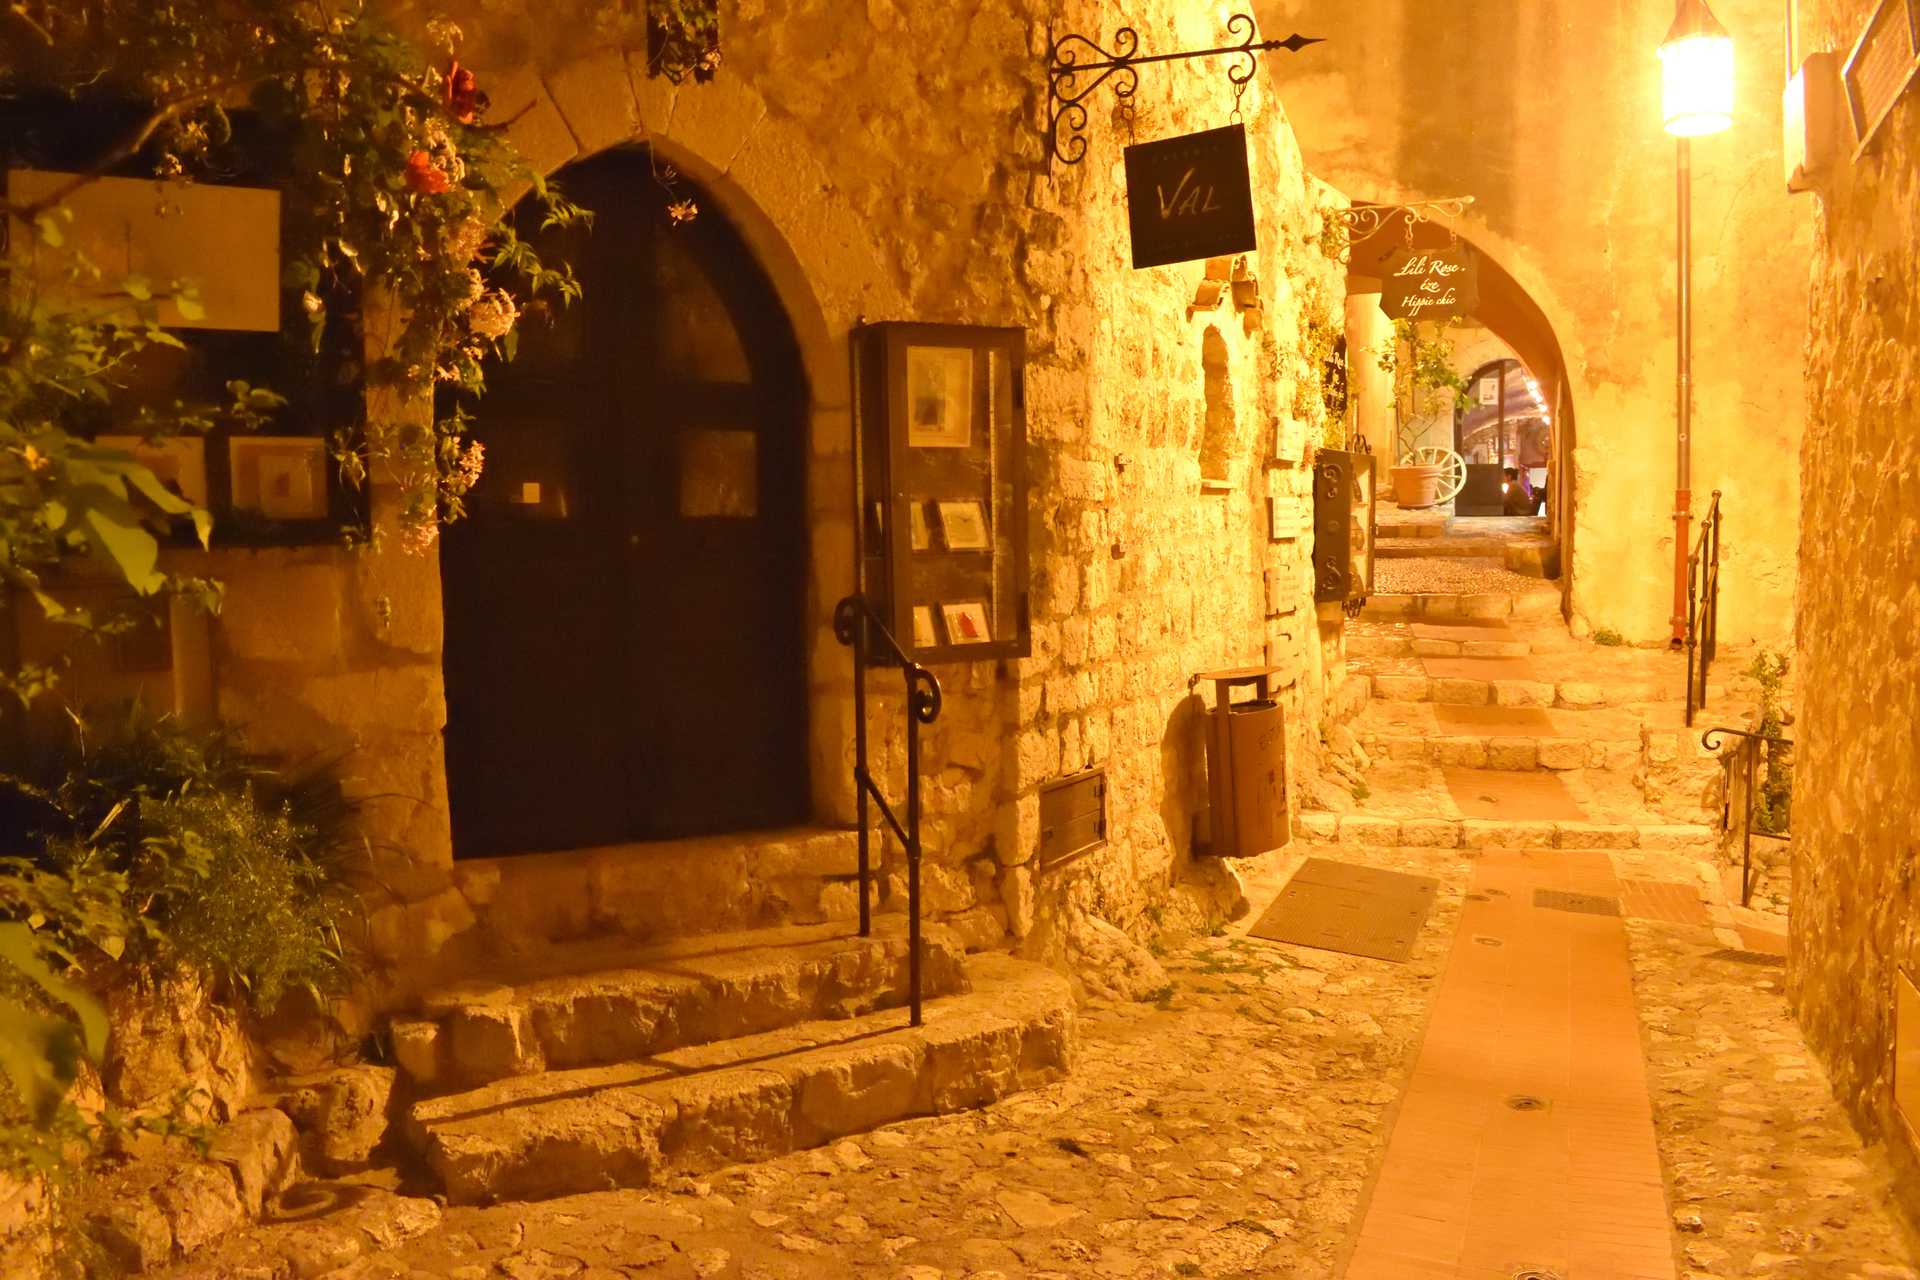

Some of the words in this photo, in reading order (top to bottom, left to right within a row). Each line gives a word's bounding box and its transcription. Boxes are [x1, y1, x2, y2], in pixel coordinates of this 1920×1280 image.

[1156, 167, 1222, 220] VAL
[1393, 256, 1428, 277] Lili
[1436, 287, 1457, 305] chic
